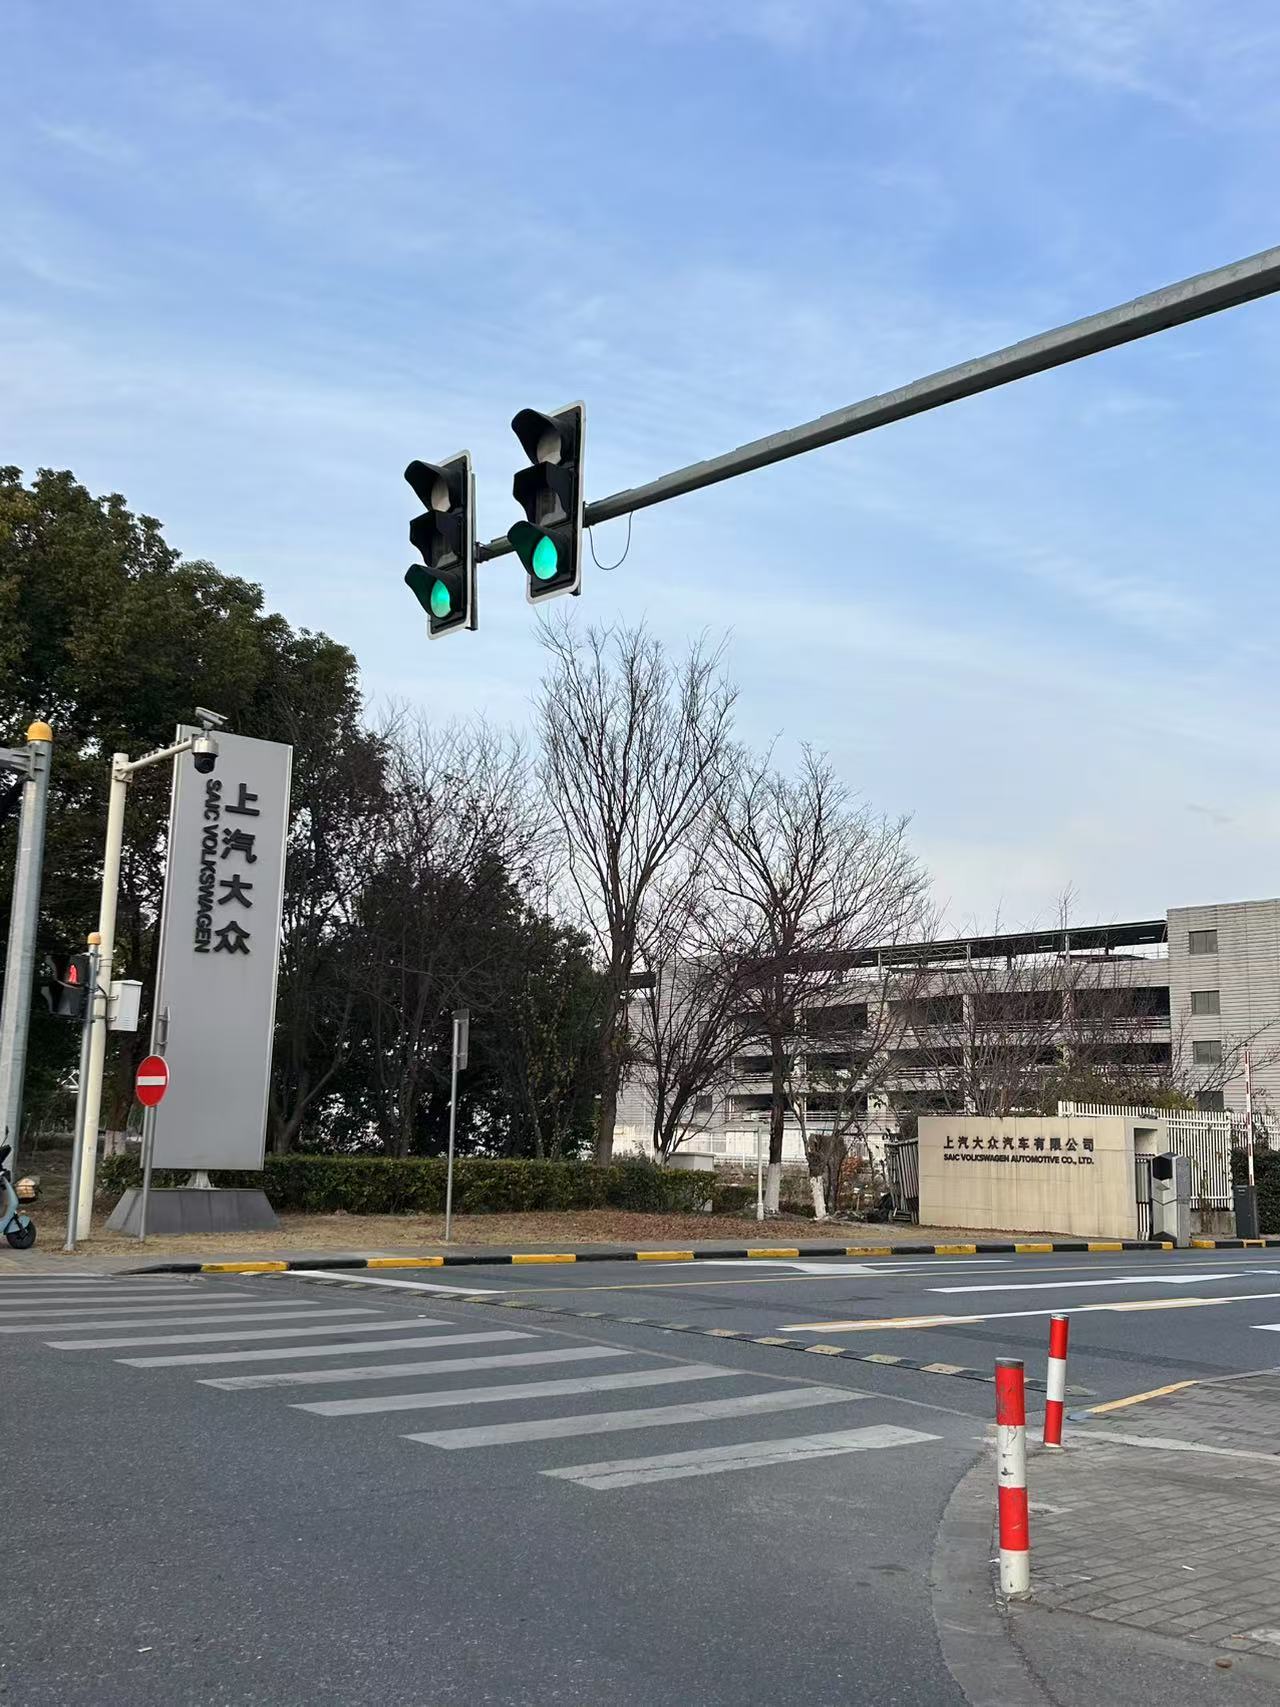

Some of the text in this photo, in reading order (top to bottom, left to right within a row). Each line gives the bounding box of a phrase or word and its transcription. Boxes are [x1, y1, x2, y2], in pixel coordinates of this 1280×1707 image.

[194, 779, 222, 953] SAIC VOLKSWAGEN
[213, 783, 260, 955] 上汽大众
[943, 1136, 1094, 1151] 上汽大众汽车有限公司
[943, 1153, 960, 1161] SAIC
[961, 1154, 1010, 1163] VOLKSWAGEN
[1011, 1155, 1060, 1164] AUTOMOTIVE
[1078, 1156, 1095, 1165] LTD.
